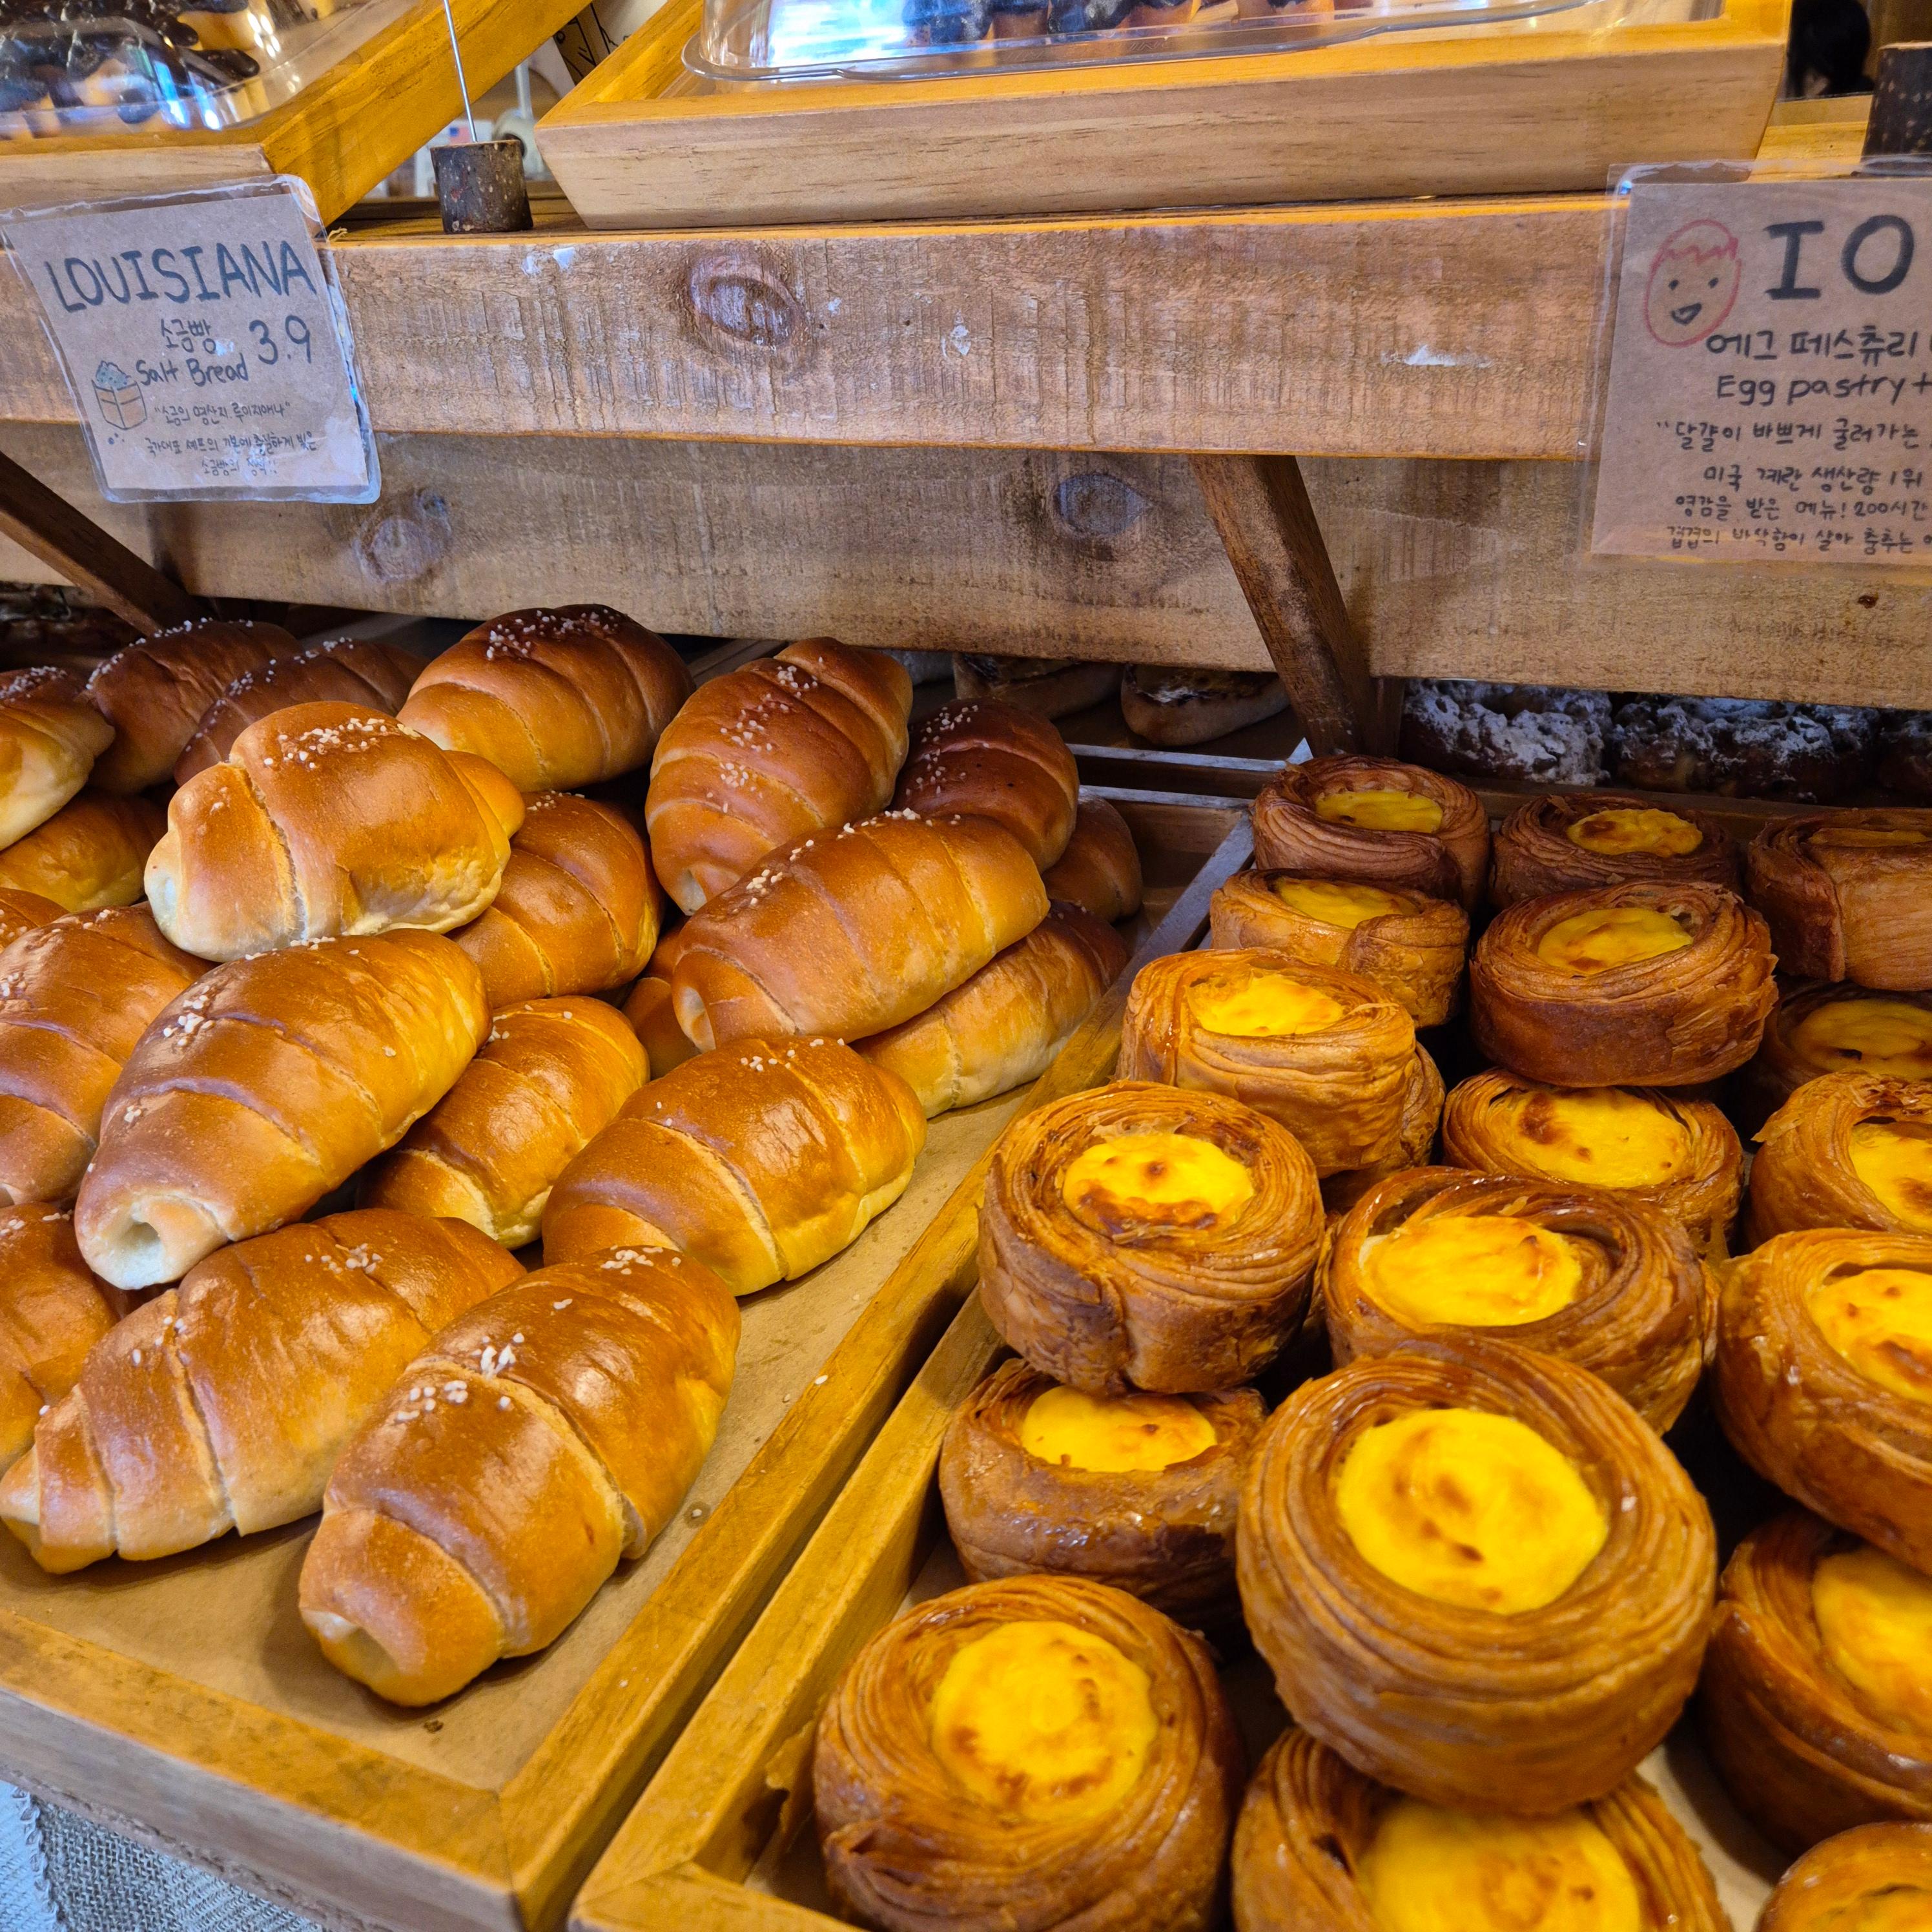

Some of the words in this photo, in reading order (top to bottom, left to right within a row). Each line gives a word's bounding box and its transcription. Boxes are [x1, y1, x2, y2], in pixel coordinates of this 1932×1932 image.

[45, 240, 318, 313] LOUISIANA
[160, 318, 217, 354] 소금빵
[248, 314, 312, 365] 3.9
[1706, 329, 1778, 360] 에그
[1789, 325, 1918, 367] 페스츄리
[135, 359, 180, 386] Salt
[185, 352, 249, 387] Bread
[1716, 375, 1776, 407] Egg
[1786, 373, 1906, 406] pastry
[1752, 422, 1821, 445] 바쁘게
[1833, 418, 1920, 451] 굴러가는
[1703, 465, 1743, 493] 미국
[1756, 466, 1802, 492] 계란
[1811, 465, 1881, 497] 생산량
[1675, 495, 1732, 521] 영감을
[1746, 498, 1779, 520] 받은
[1814, 529, 1854, 551] 살아
